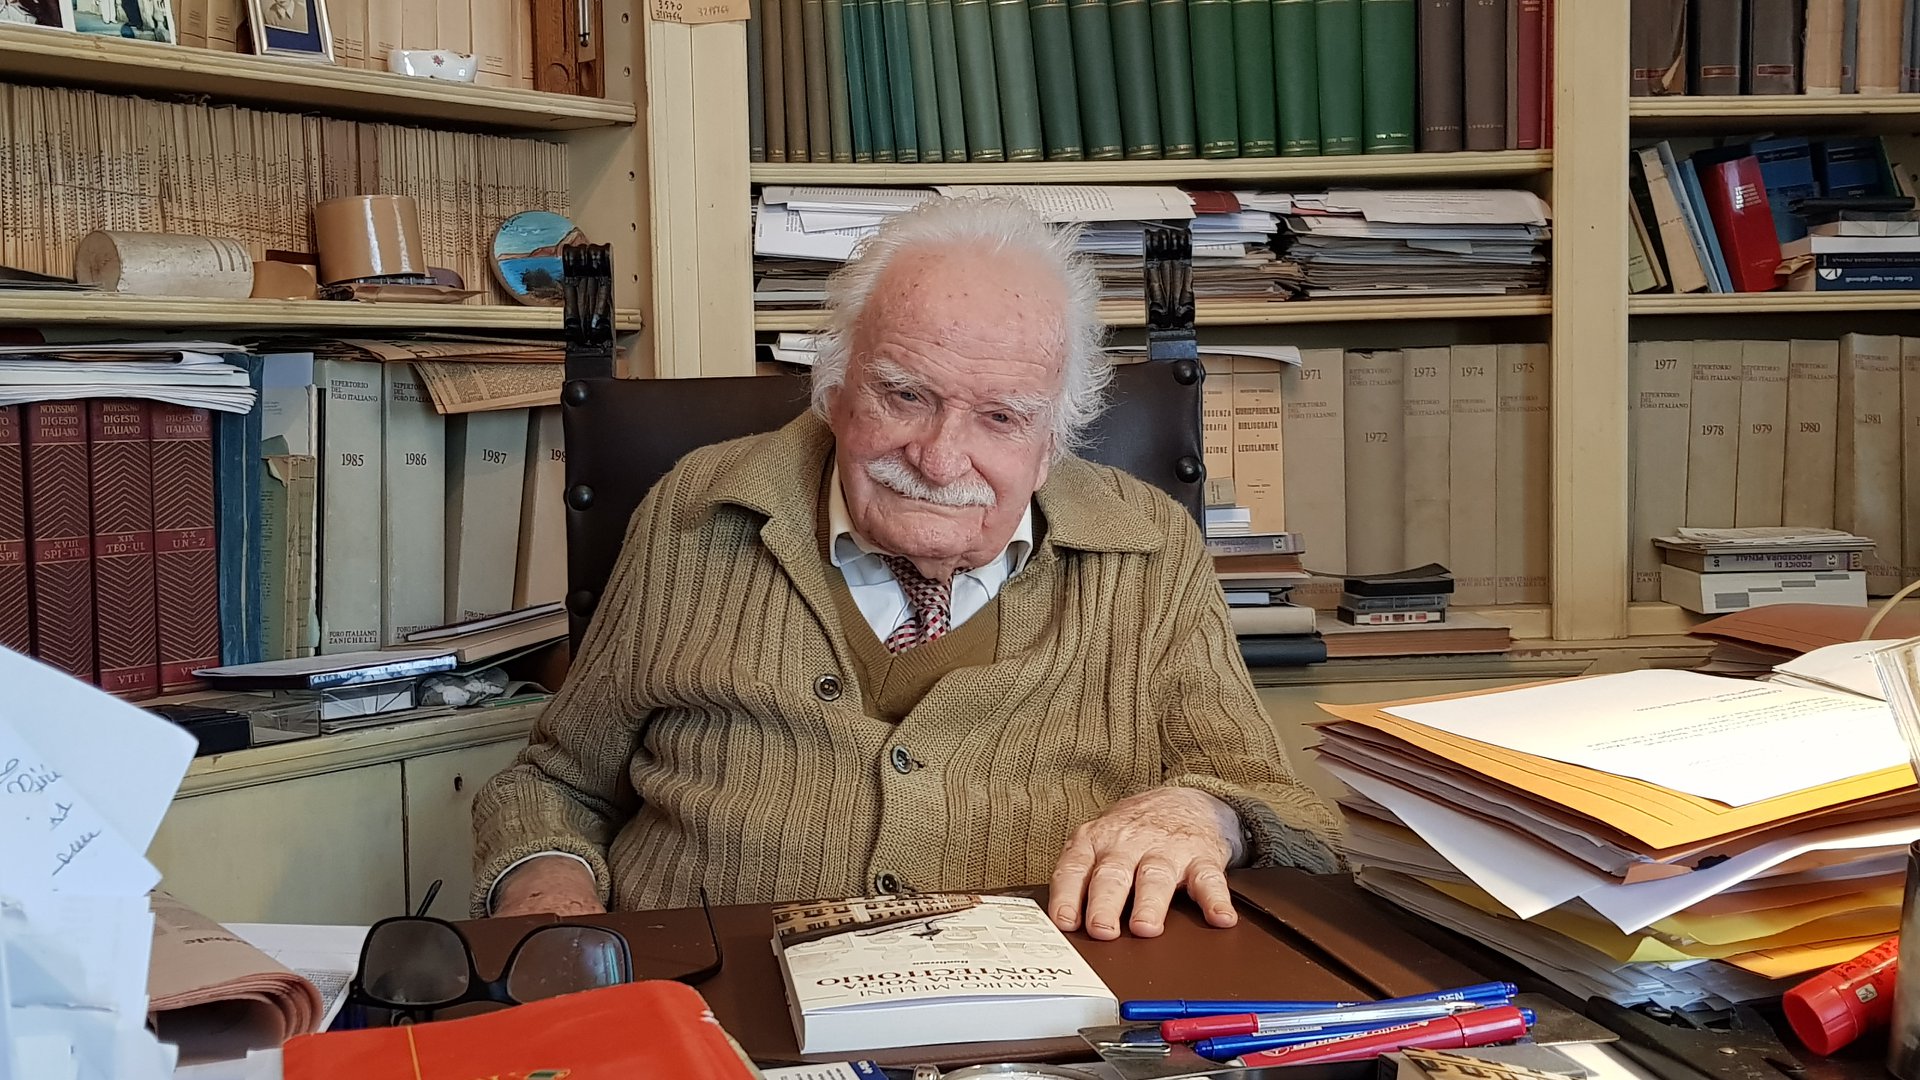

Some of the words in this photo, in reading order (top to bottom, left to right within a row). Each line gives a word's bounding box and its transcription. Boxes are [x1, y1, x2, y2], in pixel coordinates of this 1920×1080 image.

[1512, 363, 1535, 373] 1975
[1655, 359, 1677, 370] 1977
[1300, 369, 1322, 380] 1971
[1413, 367, 1437, 378] 1973
[1461, 367, 1485, 377] 1974
[40, 404, 78, 414] NOVISSIMO
[41, 416, 78, 426] DIGESTO
[103, 414, 140, 424] DIGESTO
[166, 414, 202, 423] DIGESTO
[1864, 414, 1882, 424] 1981
[104, 426, 140, 434] ITALIANO
[166, 424, 203, 434] ITALIANO
[1238, 422, 1278, 430] BIBLIOGRAFIA
[1702, 424, 1724, 436] 1978
[1752, 423, 1773, 434] 1979
[1800, 422, 1821, 433] 1980
[41, 428, 79, 437] ITALIANO
[1365, 432, 1388, 443] 1972
[1238, 444, 1279, 452] LEGISLAZIONE
[342, 453, 364, 467] 1985
[405, 452, 427, 466] 1986
[482, 448, 507, 464] 1987
[551, 448, 566, 462] 198
[118, 534, 135, 542] XIX
[182, 530, 196, 538] XX
[54, 540, 80, 549] XVIII
[1736, 554, 1764, 562] PENALE
[1766, 554, 1812, 562] PROCEDURA
[816, 967, 1073, 986] MONTECITORIO
[842, 978, 919, 990] VOLTA
[960, 981, 1049, 989] MAURO
[859, 984, 950, 997] MELLINI
